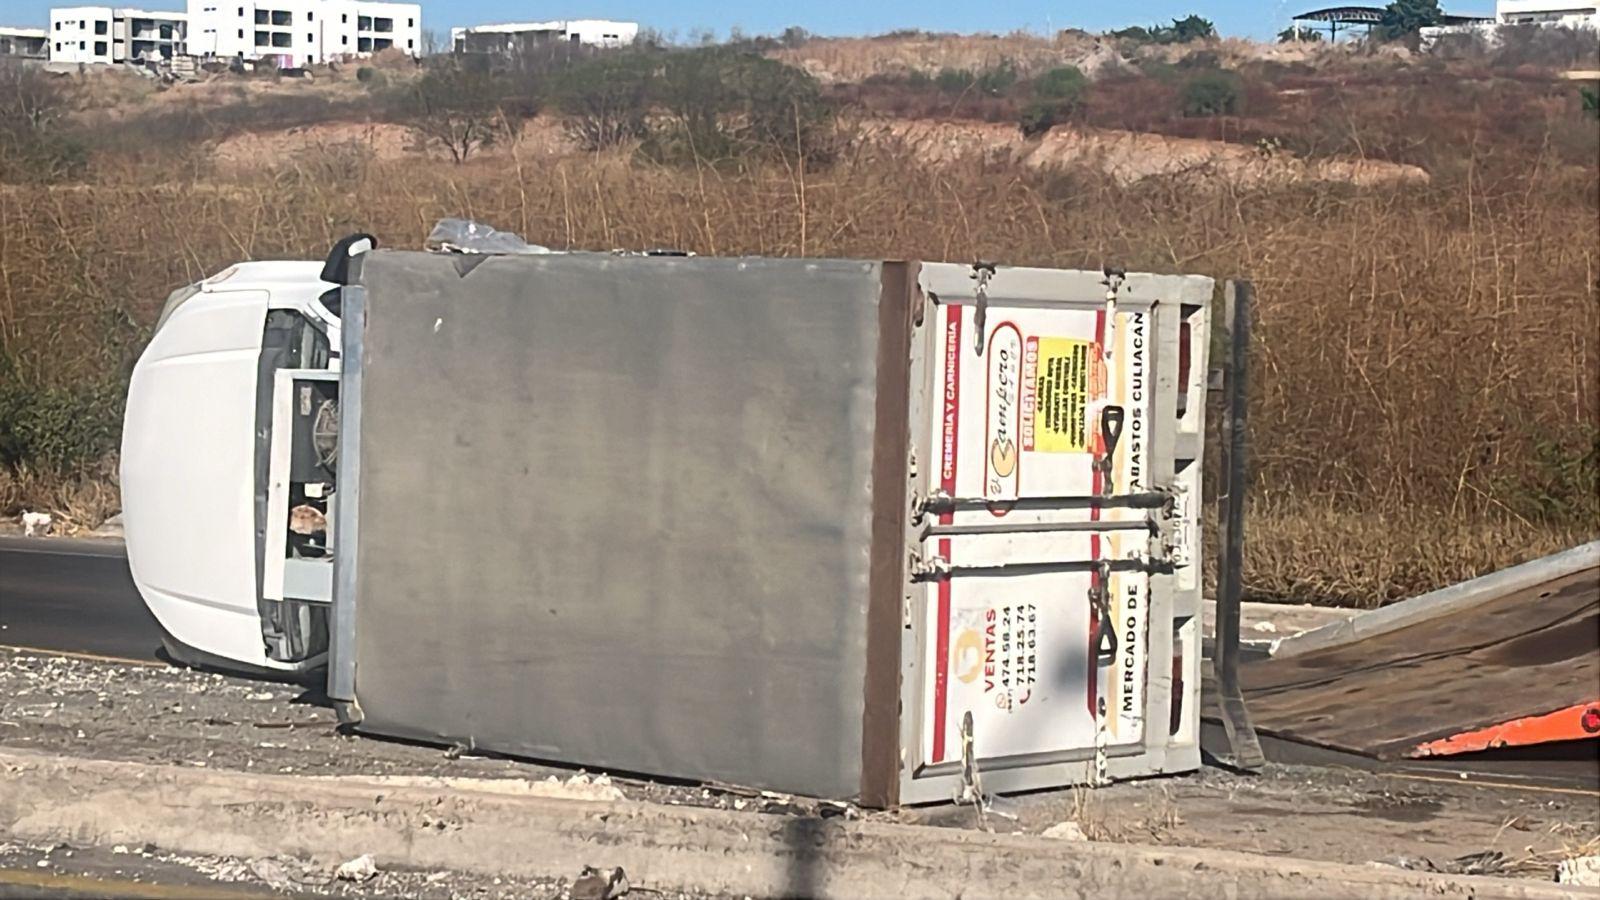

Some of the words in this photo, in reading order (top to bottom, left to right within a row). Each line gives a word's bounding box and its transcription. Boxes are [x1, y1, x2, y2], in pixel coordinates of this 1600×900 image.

[947, 403, 958, 413] Y
[1023, 341, 1038, 446] SOLICITAMOS
[1129, 407, 1142, 488] ABASTOS
[1127, 584, 1138, 610] DE
[984, 608, 996, 693] VENTAS
[1016, 604, 1025, 686] 718.25.74
[1028, 603, 1036, 685] 718.63.67
[1123, 616, 1137, 712] MERCADO
